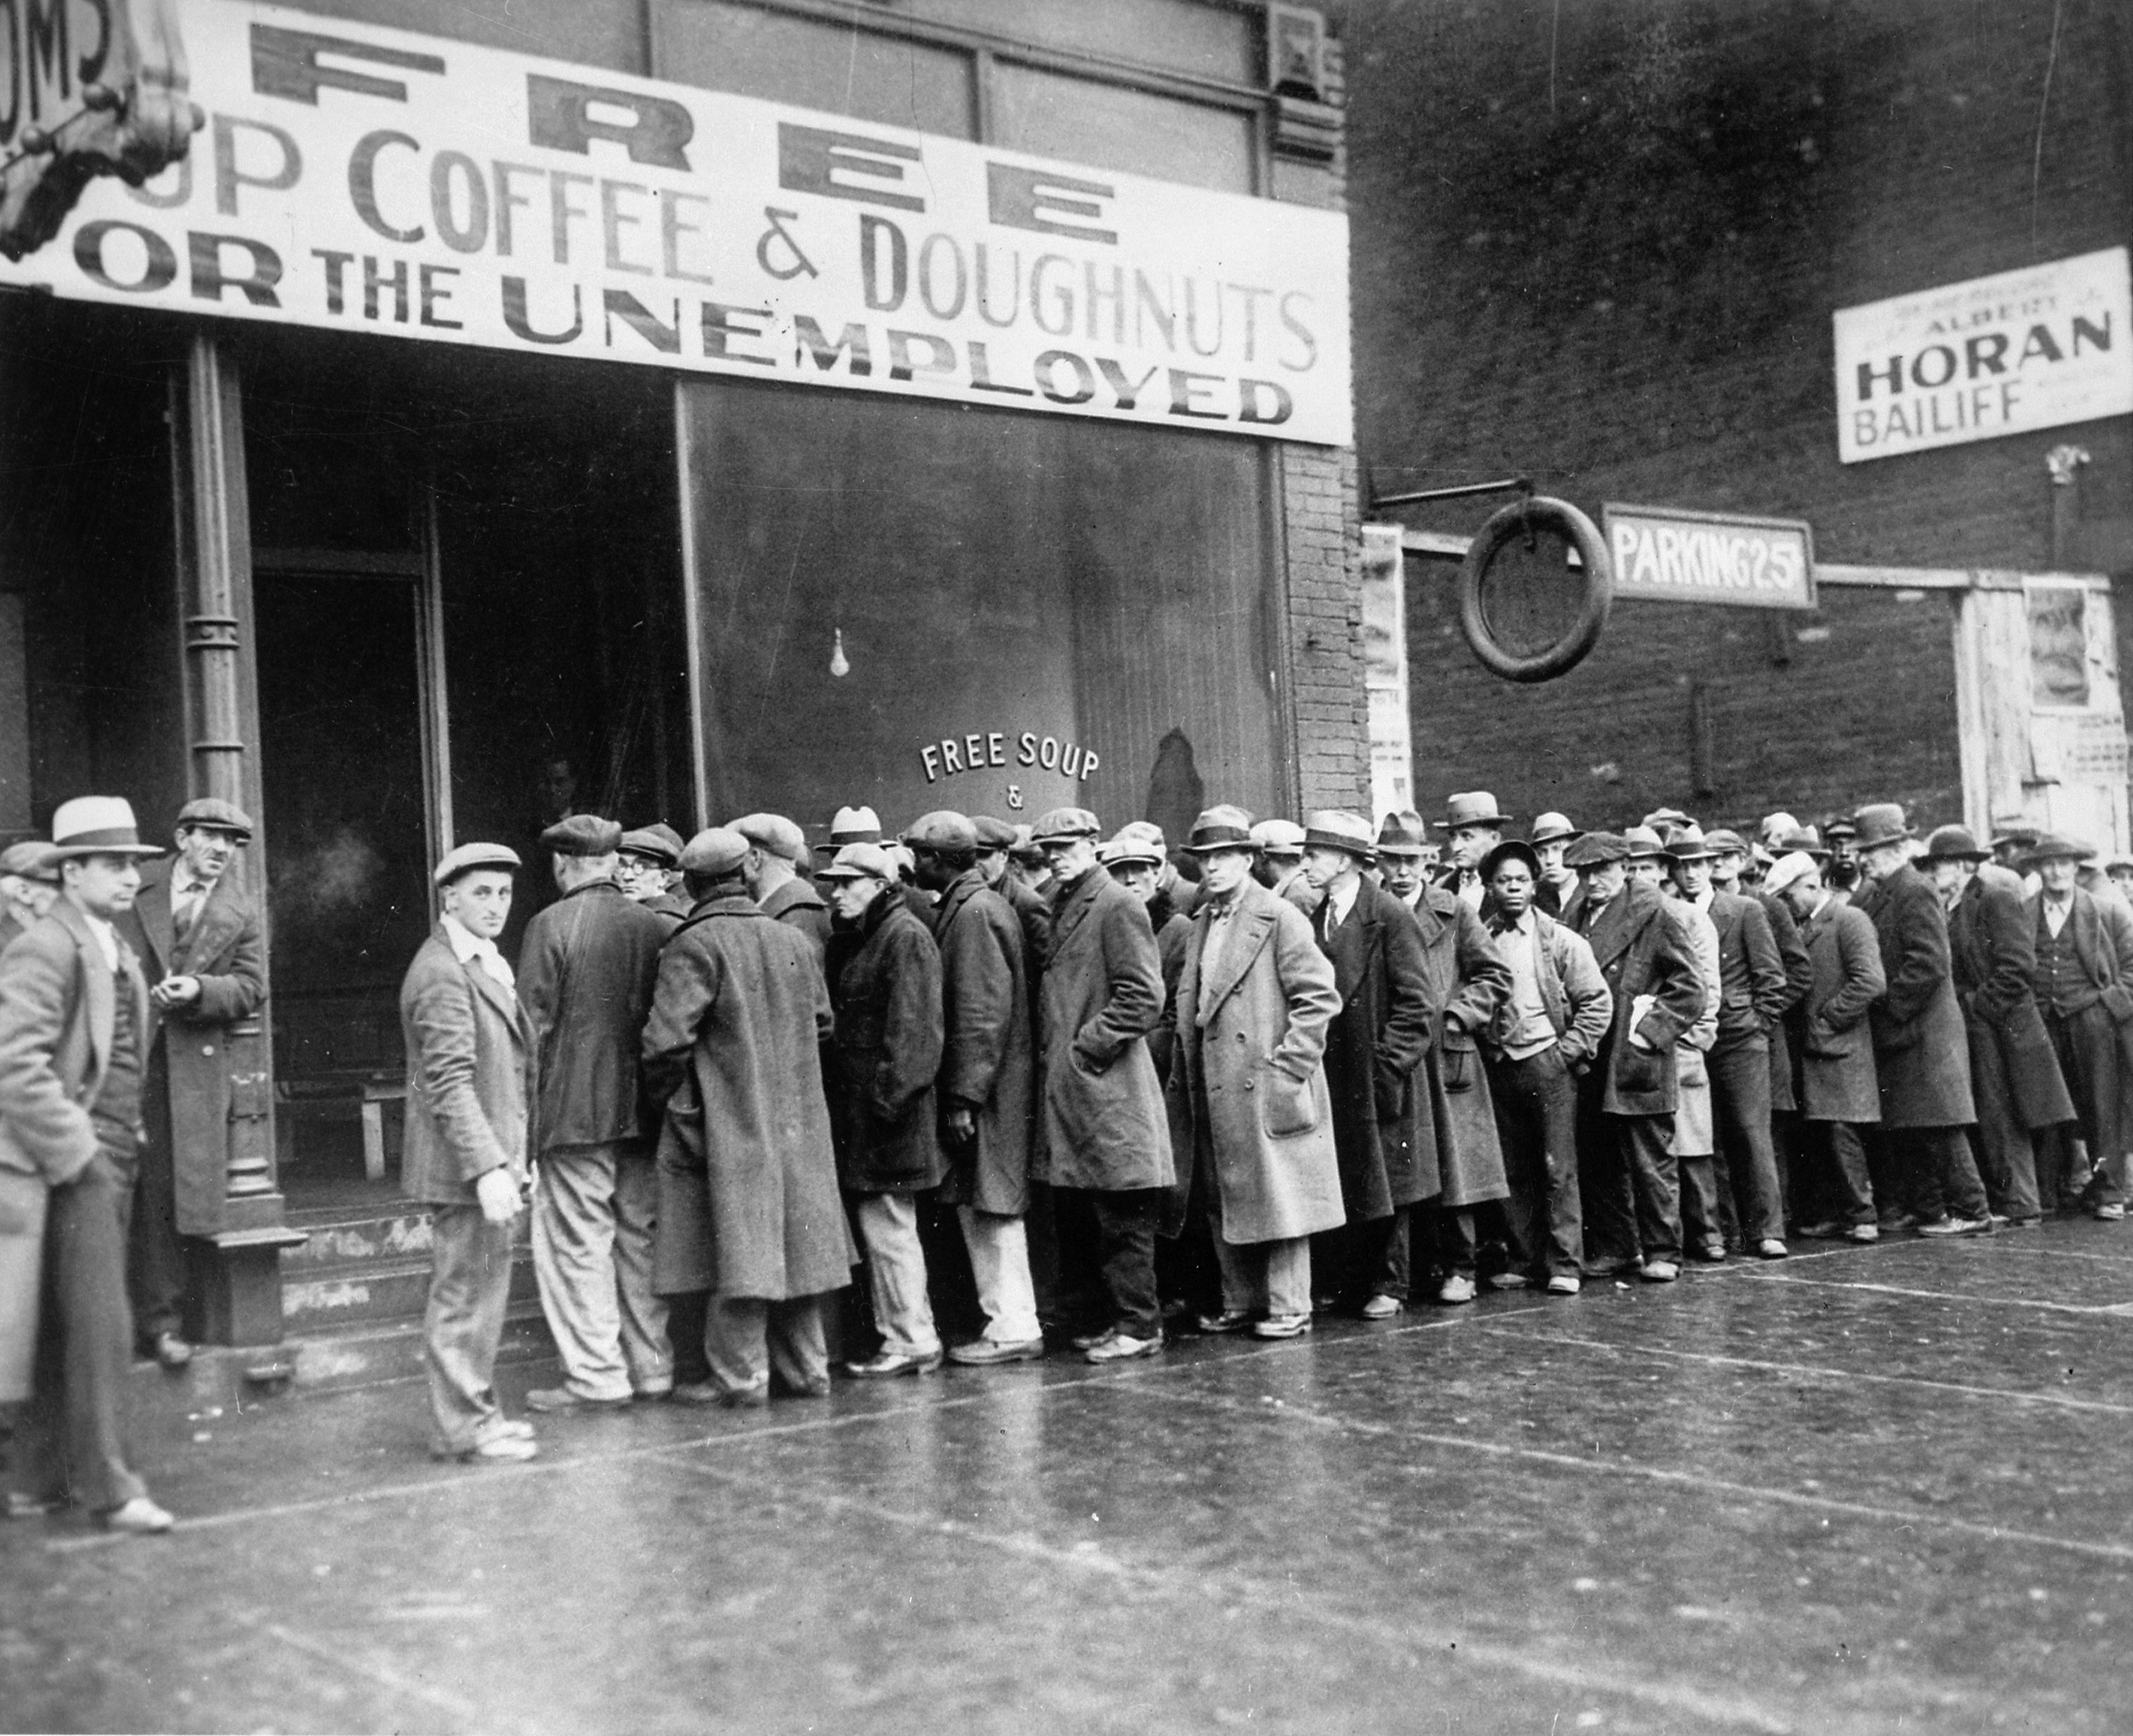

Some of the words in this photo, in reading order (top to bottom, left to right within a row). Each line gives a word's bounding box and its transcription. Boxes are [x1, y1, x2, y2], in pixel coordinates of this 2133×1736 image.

[250, 22, 1118, 245] FREE
[348, 128, 713, 285] COFFEE
[756, 205, 819, 280] &
[860, 213, 1317, 372] DOUGHNUTS
[311, 248, 464, 329] THE
[501, 275, 1293, 425] UNEMPLOYED
[1856, 311, 2111, 401] HORAN
[1854, 380, 2022, 447] BAILIFF
[921, 733, 1006, 782] FREE
[1018, 732, 1099, 780] SOUP
[1008, 785, 1023, 808] &
